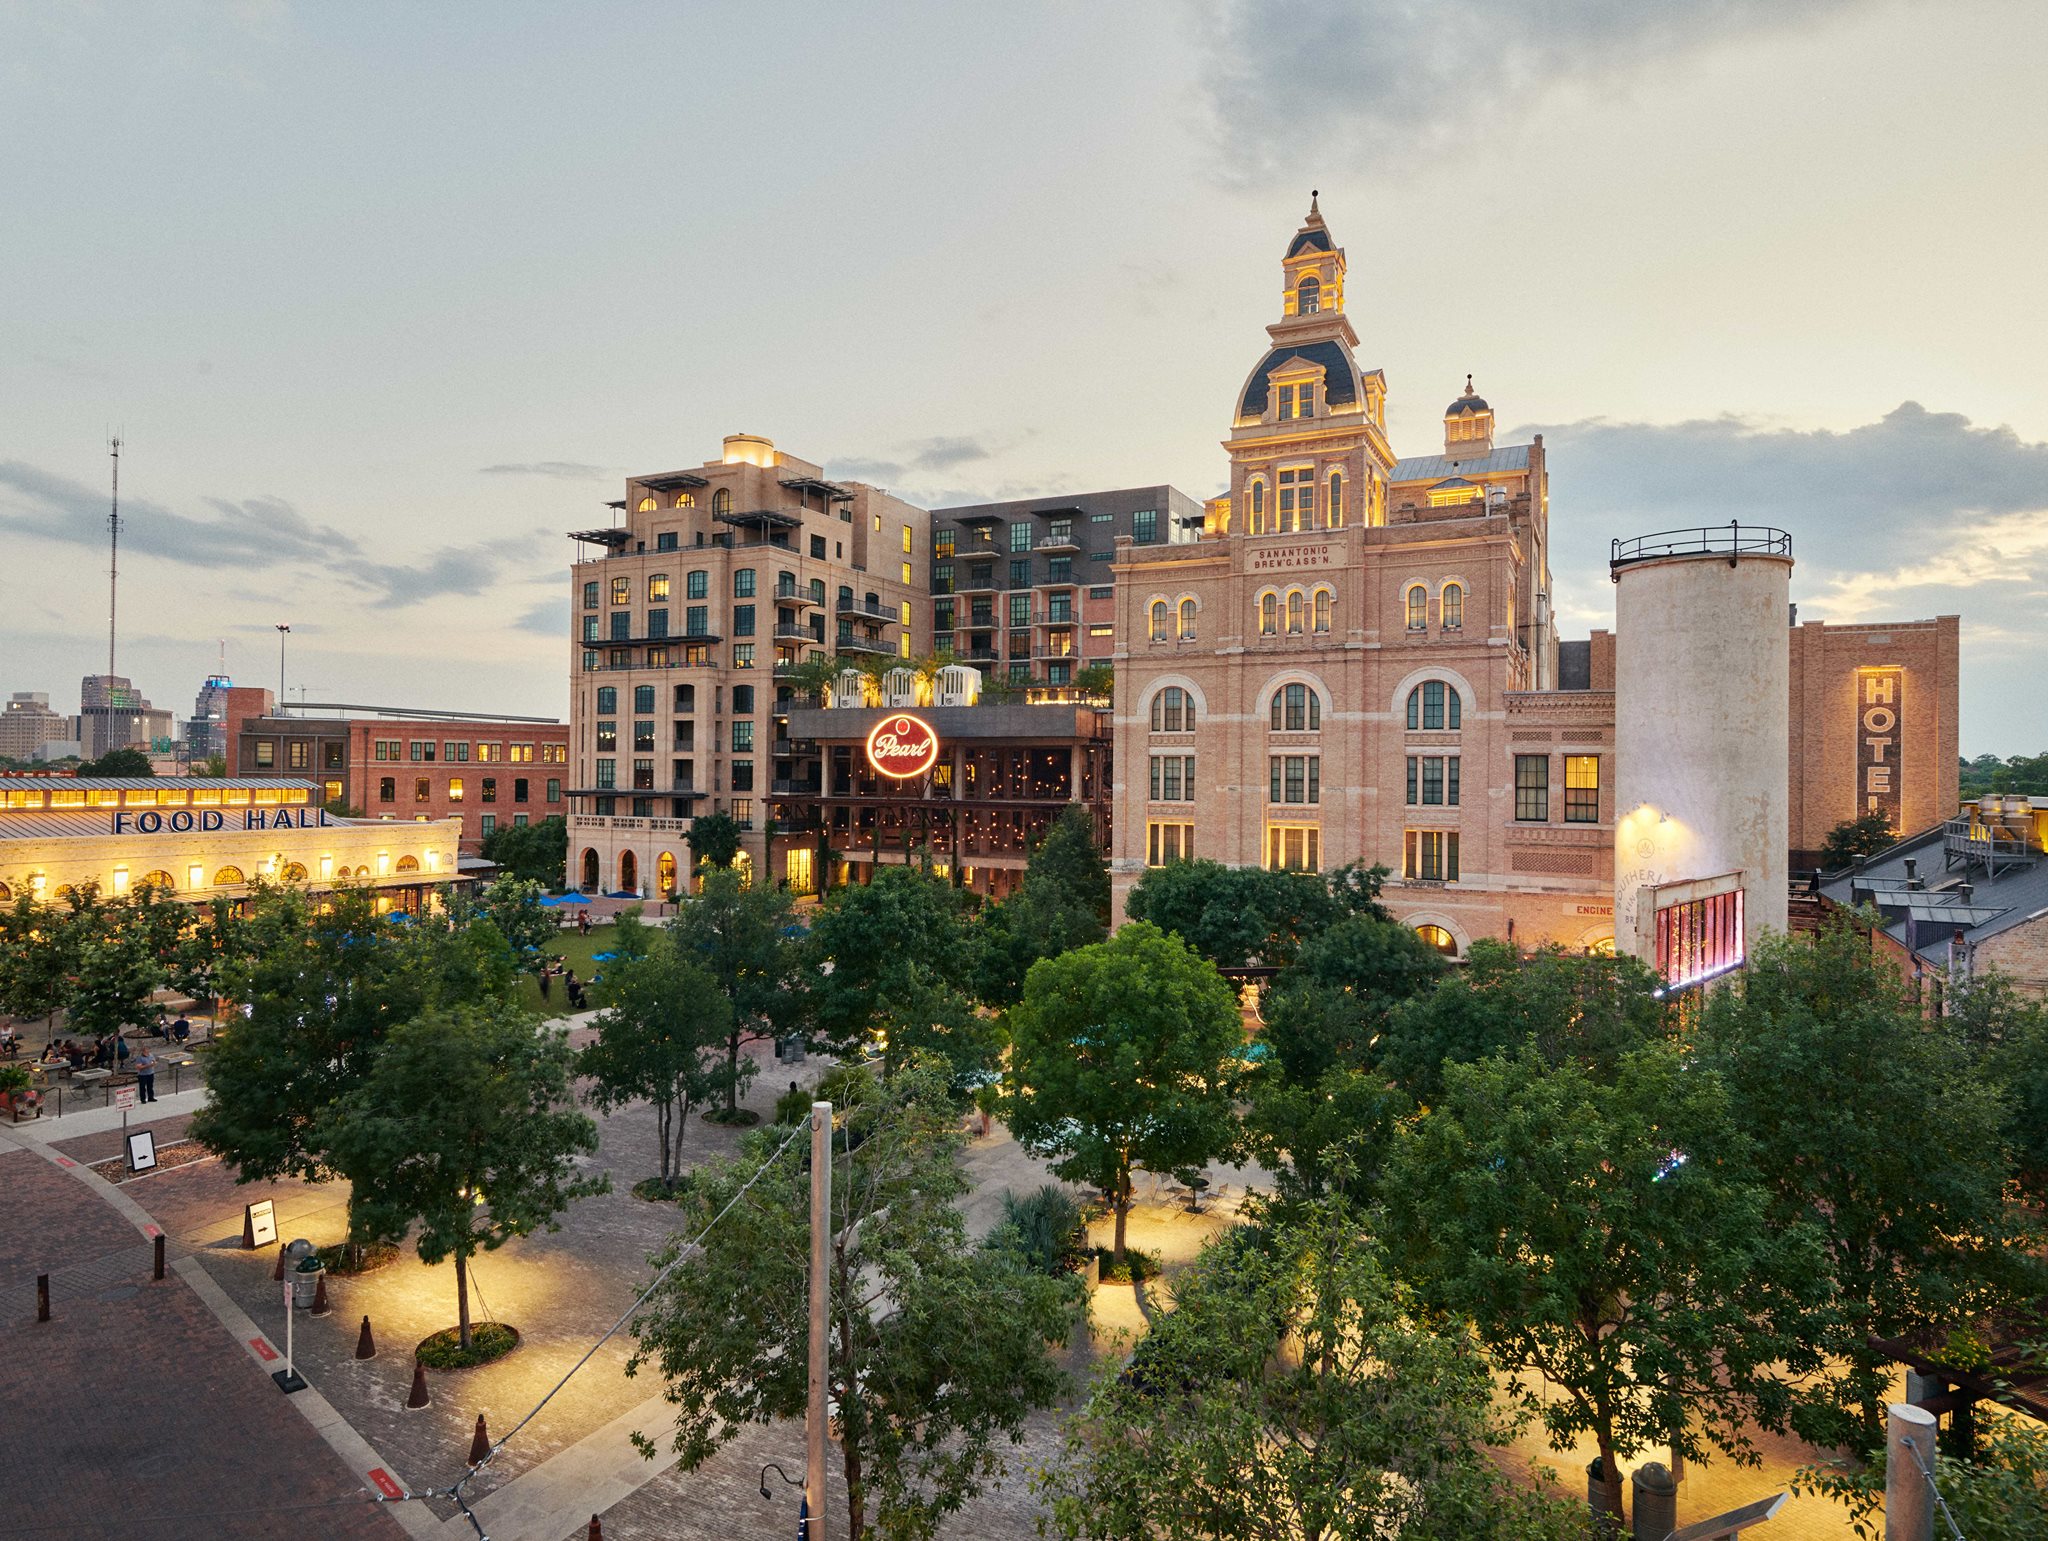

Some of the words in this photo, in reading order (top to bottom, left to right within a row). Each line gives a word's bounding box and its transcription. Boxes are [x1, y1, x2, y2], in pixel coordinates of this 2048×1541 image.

[874, 733, 932, 759] Pearl
[113, 809, 224, 834] FOOD
[244, 807, 333, 831] HALL
[1616, 869, 1664, 910] SOUTHERL
[1576, 905, 1613, 916] ENGINE
[1625, 894, 1636, 913] FIN
